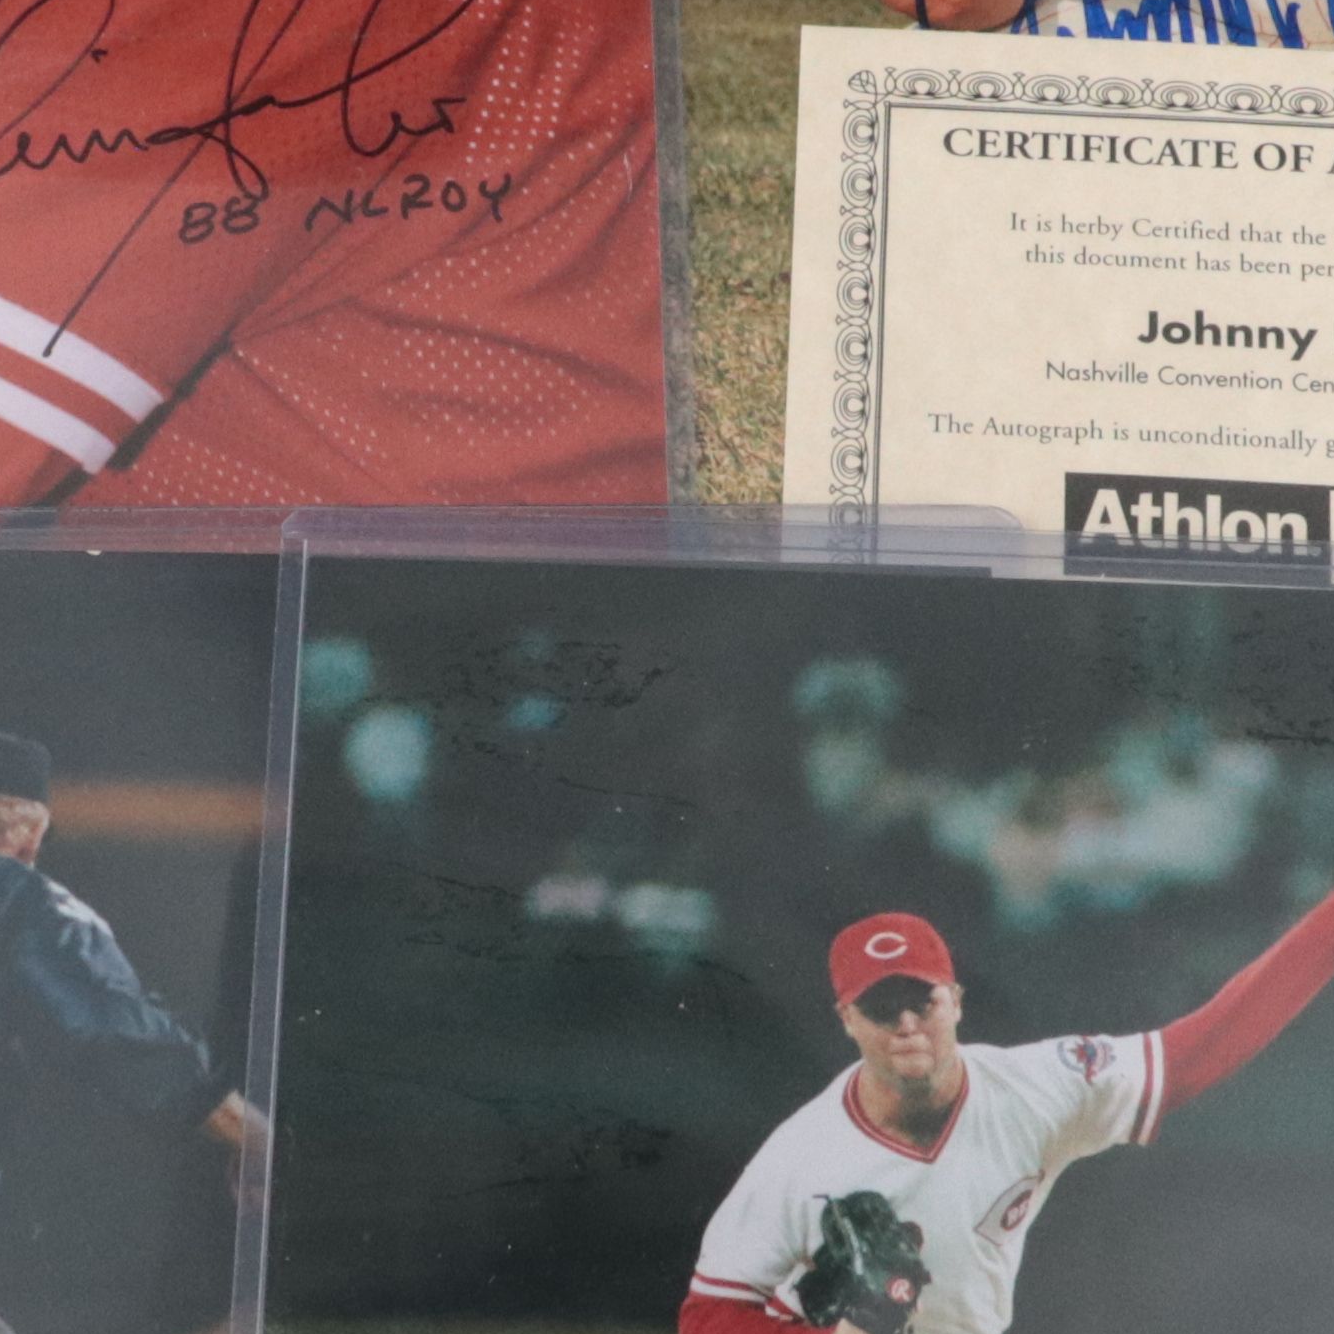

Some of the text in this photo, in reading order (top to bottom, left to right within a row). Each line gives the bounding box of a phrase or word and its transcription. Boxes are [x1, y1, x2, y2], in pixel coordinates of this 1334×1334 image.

[942, 127, 1239, 170] CERTIFICATE
[1252, 142, 1315, 173] OF
[178, 196, 261, 245] 88
[1011, 212, 1027, 232] It
[1036, 214, 1052, 232] is
[1061, 213, 1124, 242] herby
[1131, 218, 1230, 242] Certified
[1239, 222, 1282, 244] that
[1292, 224, 1326, 246] the
[1025, 243, 1065, 264] this
[1073, 245, 1187, 270] document
[1196, 250, 1231, 272] has
[1239, 252, 1291, 275] been
[1137, 309, 1318, 361] Johnny
[1046, 359, 1149, 385] Nashville
[1157, 365, 1283, 390] Convention
[927, 412, 974, 435] The
[982, 416, 1103, 446] Autograph
[1113, 422, 1130, 441] is
[1138, 425, 1317, 457] unconditionally
[1078, 487, 1313, 558] Athlon
[865, 931, 908, 960] C
